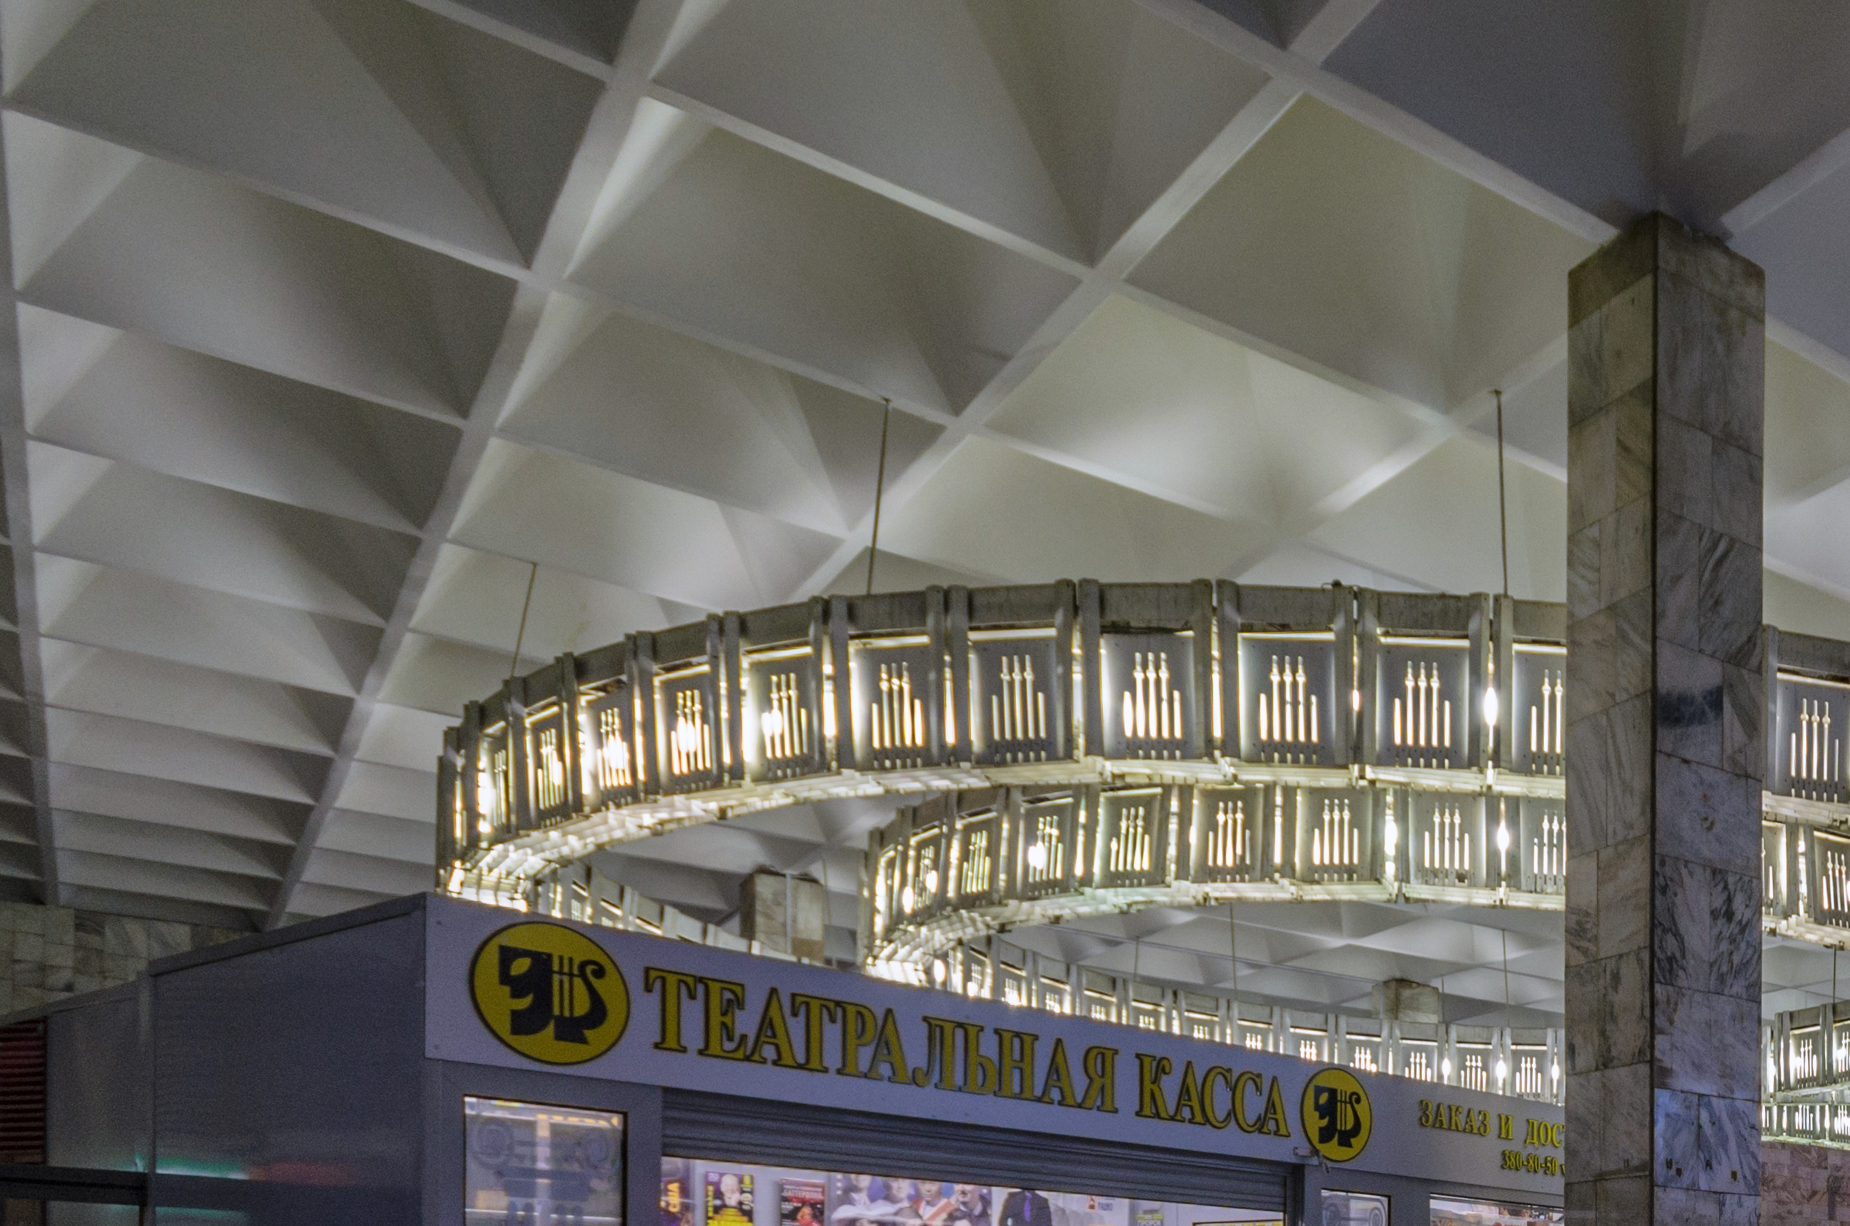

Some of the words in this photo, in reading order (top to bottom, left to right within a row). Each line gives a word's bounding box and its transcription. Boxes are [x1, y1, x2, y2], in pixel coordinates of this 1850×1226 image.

[643, 965, 1120, 1115] ТЕАТРАЛЬНАЯ
[1135, 1051, 1291, 1139] КАССА
[1419, 1099, 1491, 1137] ЗАКАЗ
[1497, 1112, 1514, 1141] И
[1524, 1117, 1565, 1149] ДОС
[1501, 1149, 1559, 1176] 380-80-50
